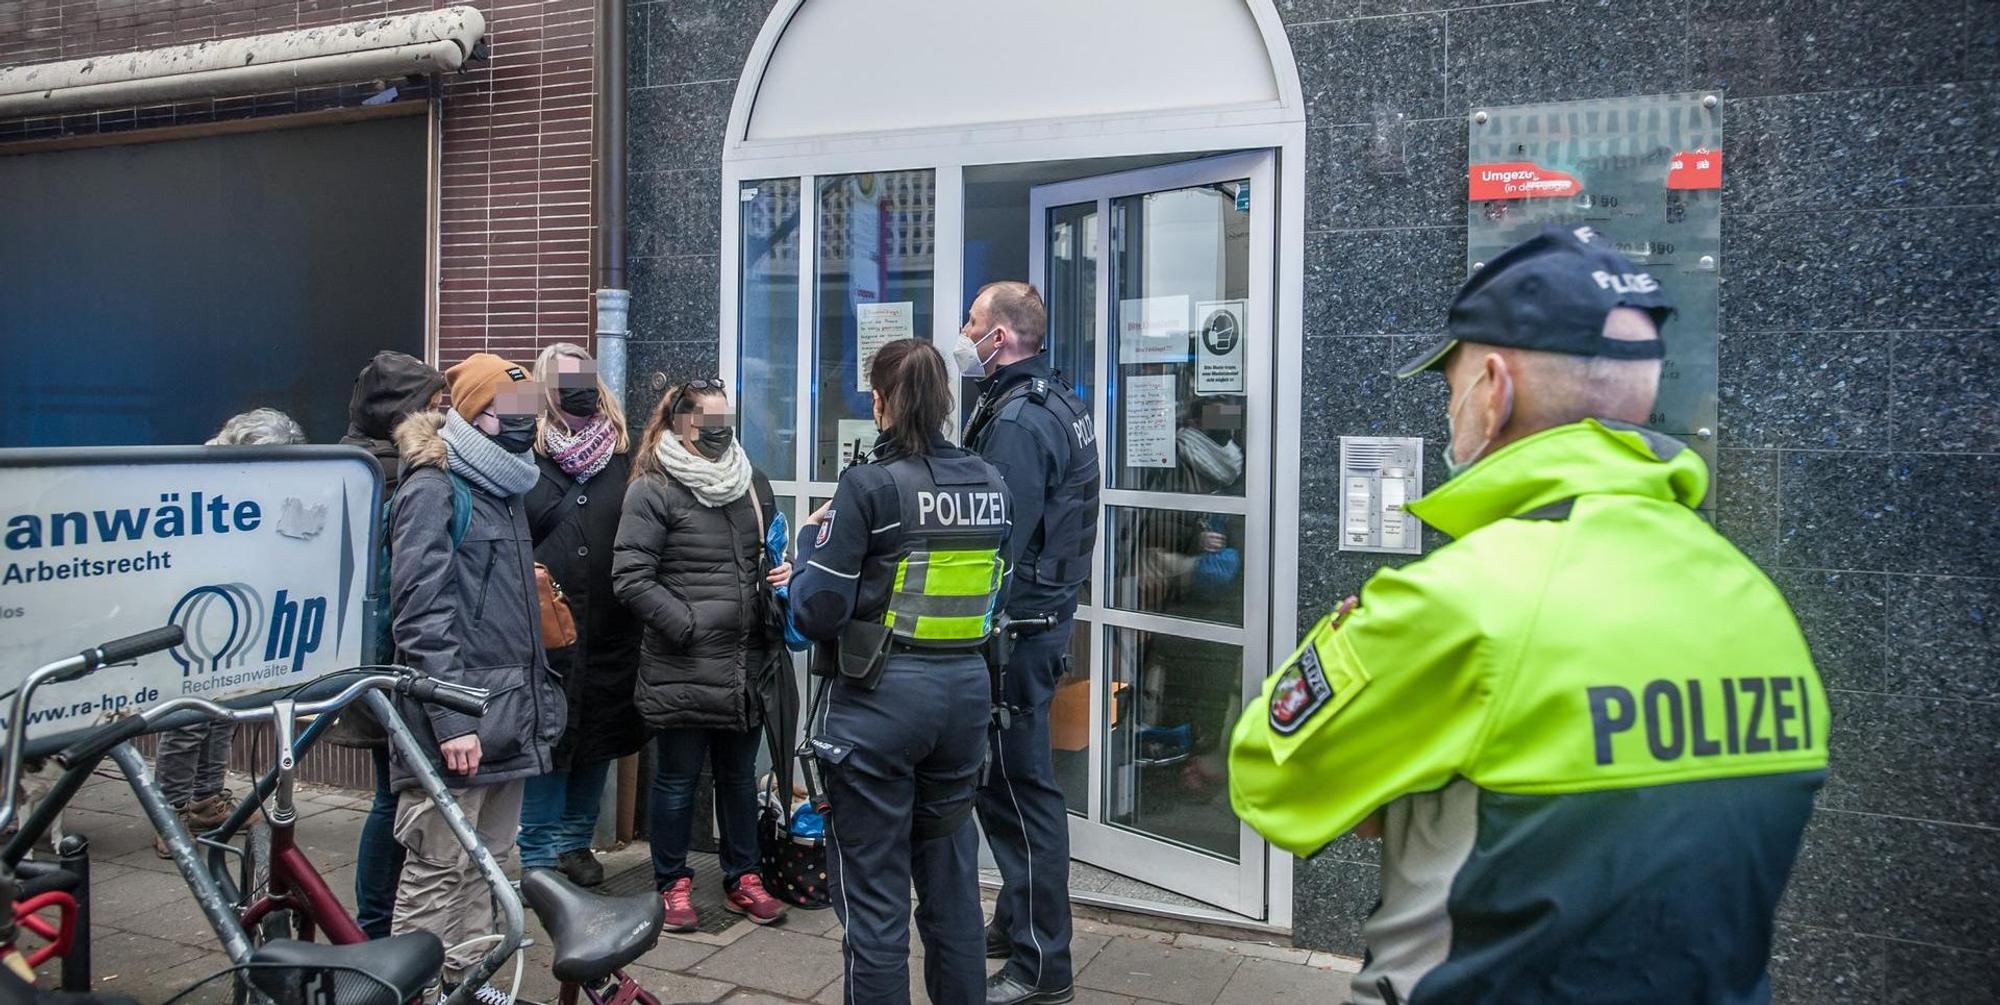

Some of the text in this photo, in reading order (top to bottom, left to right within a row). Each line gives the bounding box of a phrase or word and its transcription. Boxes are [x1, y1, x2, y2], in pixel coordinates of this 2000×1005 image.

[4, 491, 262, 551] anwälte
[918, 491, 1005, 527] POLIZEI
[2, 551, 172, 586] Arbeitsrecht
[264, 589, 327, 673] hp
[181, 664, 288, 695] Rechtsanwälte
[1586, 676, 1812, 766] POLIZEI
